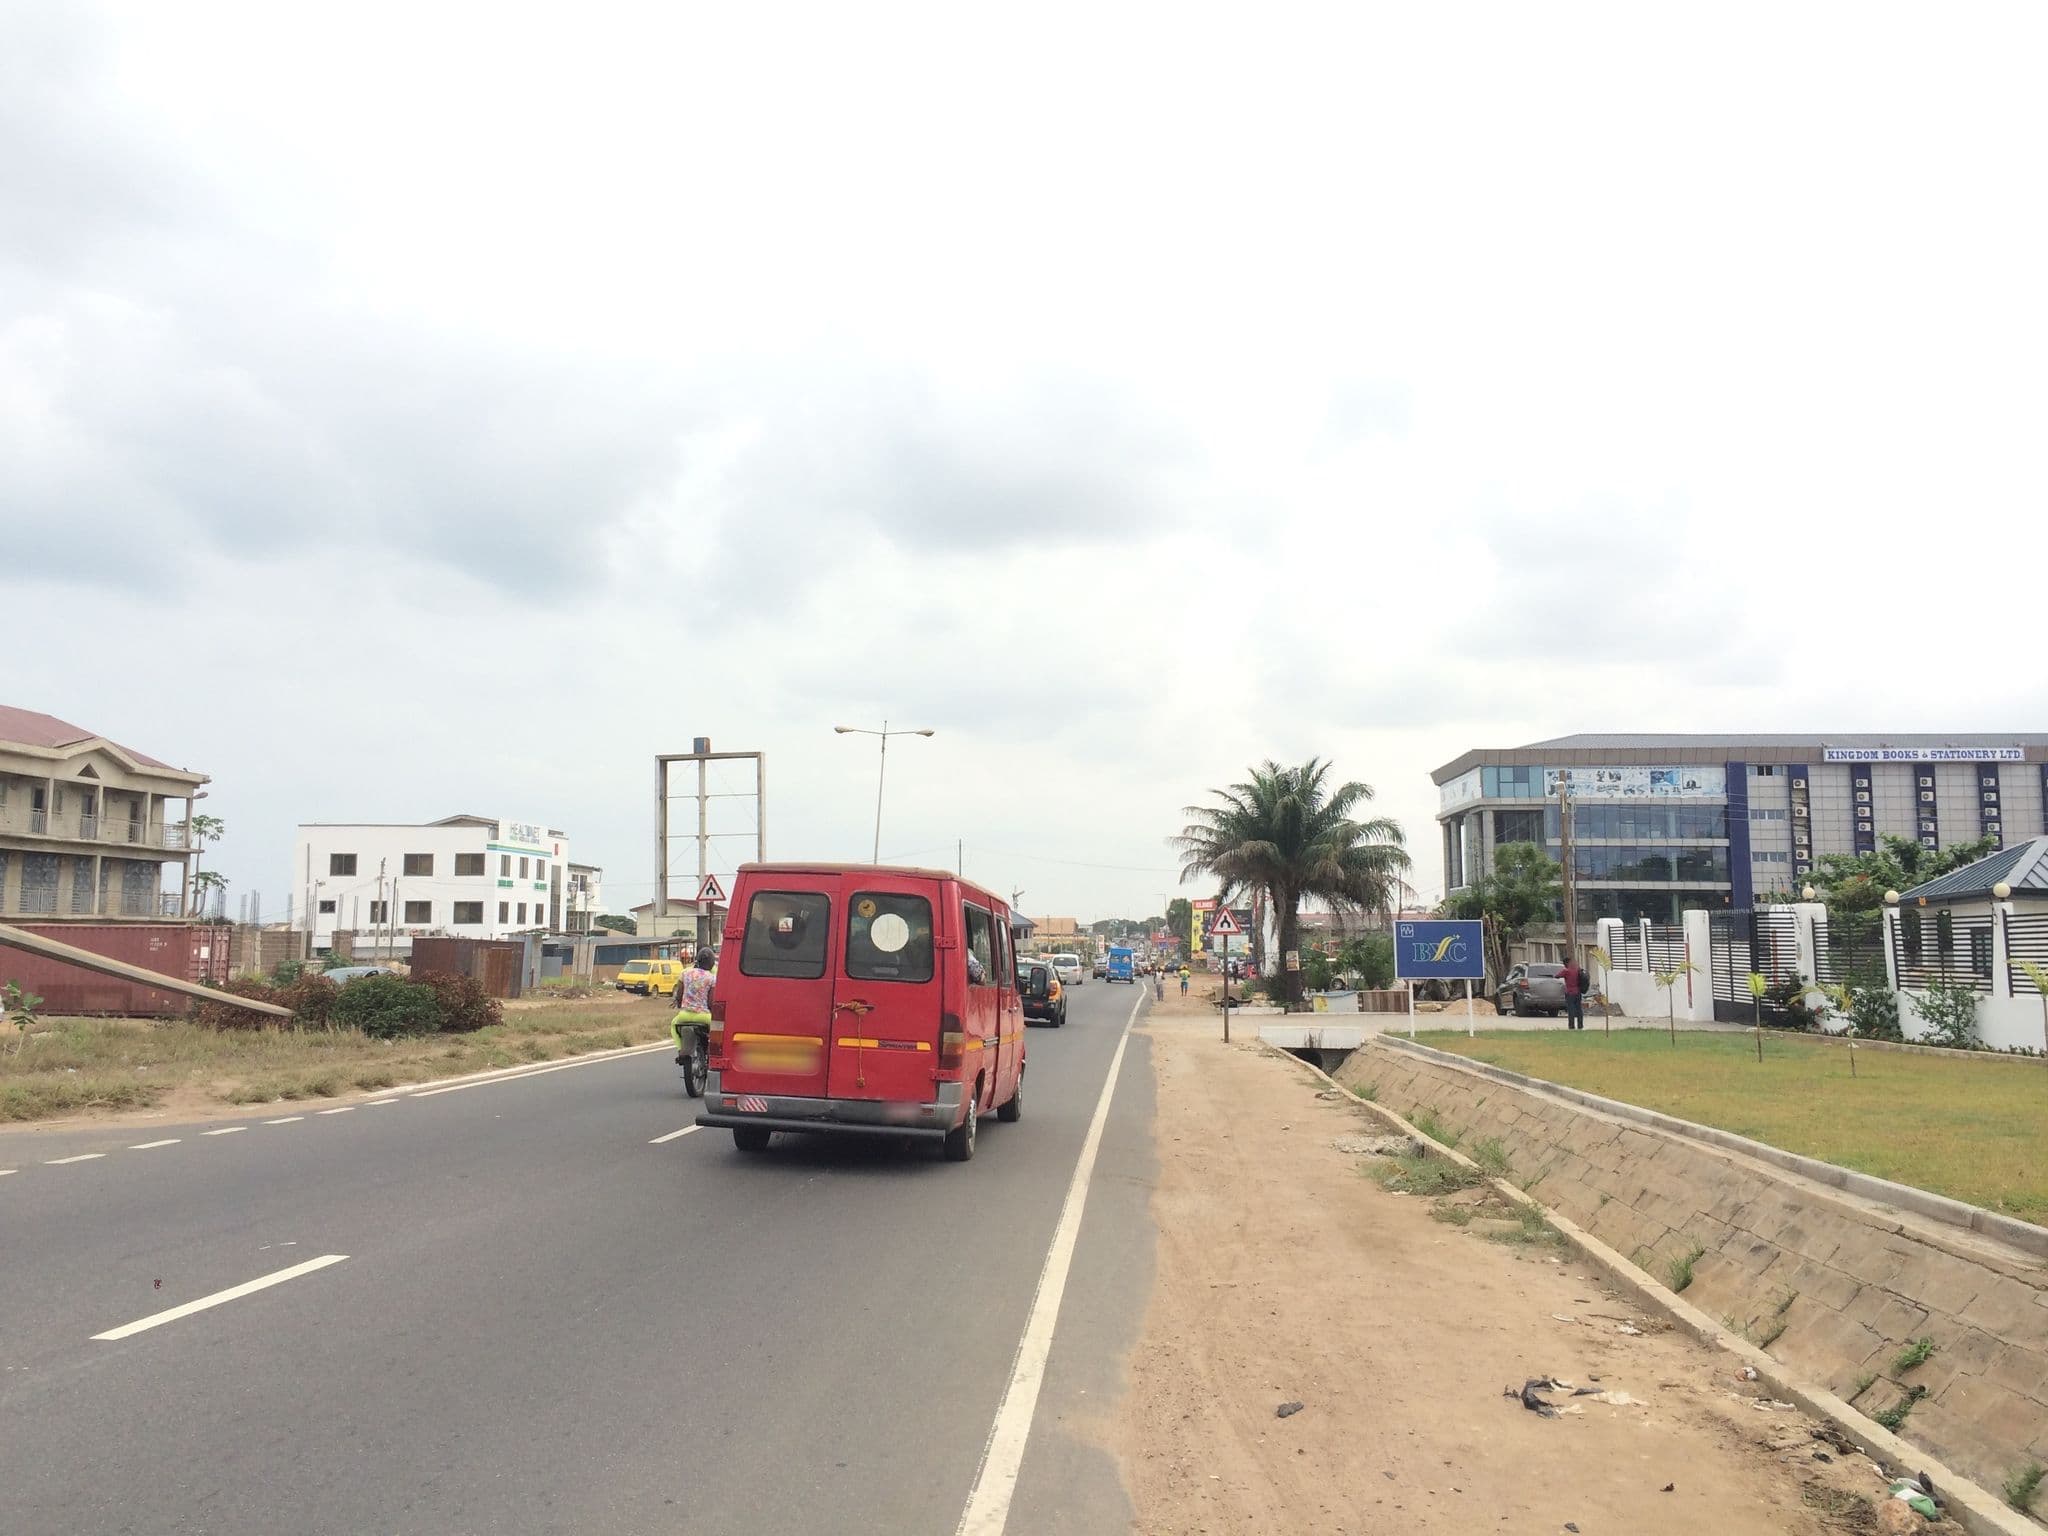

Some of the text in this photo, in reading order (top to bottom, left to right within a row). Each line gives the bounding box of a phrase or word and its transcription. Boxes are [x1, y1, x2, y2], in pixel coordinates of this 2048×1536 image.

[1827, 750, 1879, 760] KINGDOM
[1883, 750, 1919, 760] BOOKS
[1930, 750, 1997, 759] STATIONERY
